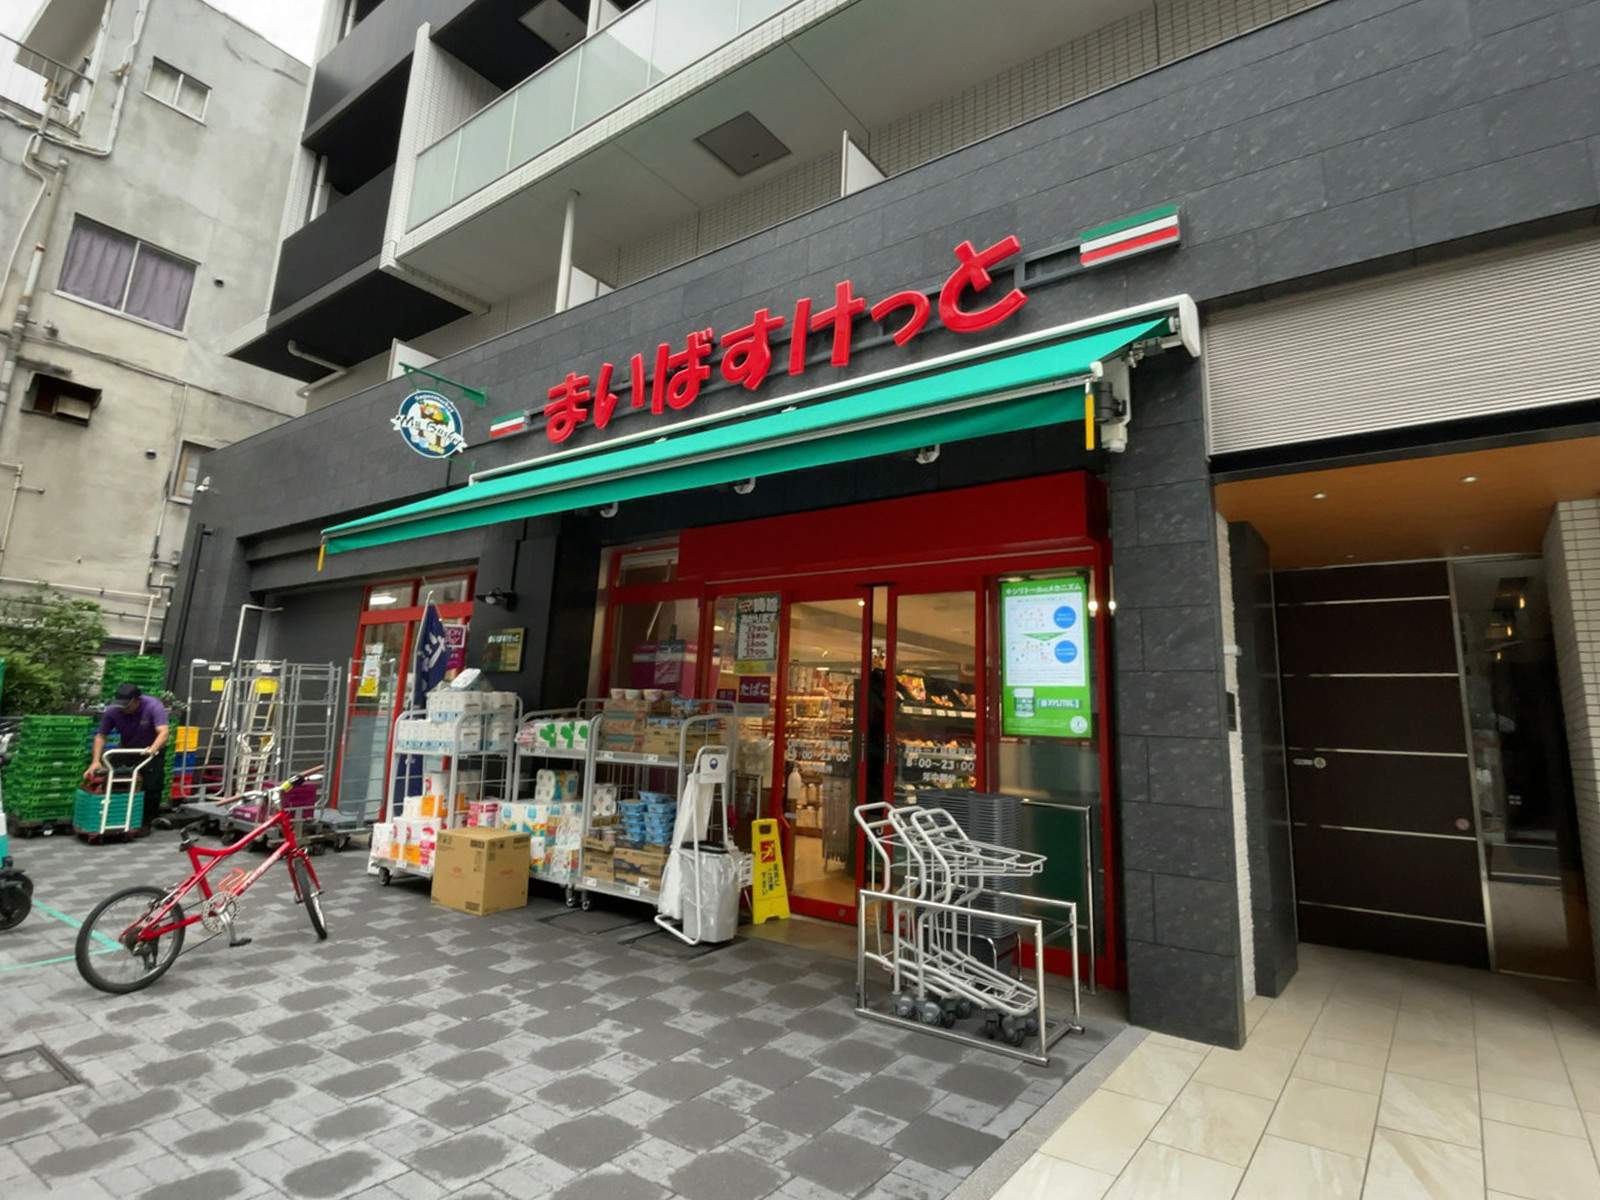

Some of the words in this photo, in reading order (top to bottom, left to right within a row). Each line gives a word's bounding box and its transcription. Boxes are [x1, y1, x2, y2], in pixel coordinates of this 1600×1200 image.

[543, 234, 1028, 444] まいばすけっと
[396, 415, 422, 431] My
[740, 682, 770, 696] たばこ
